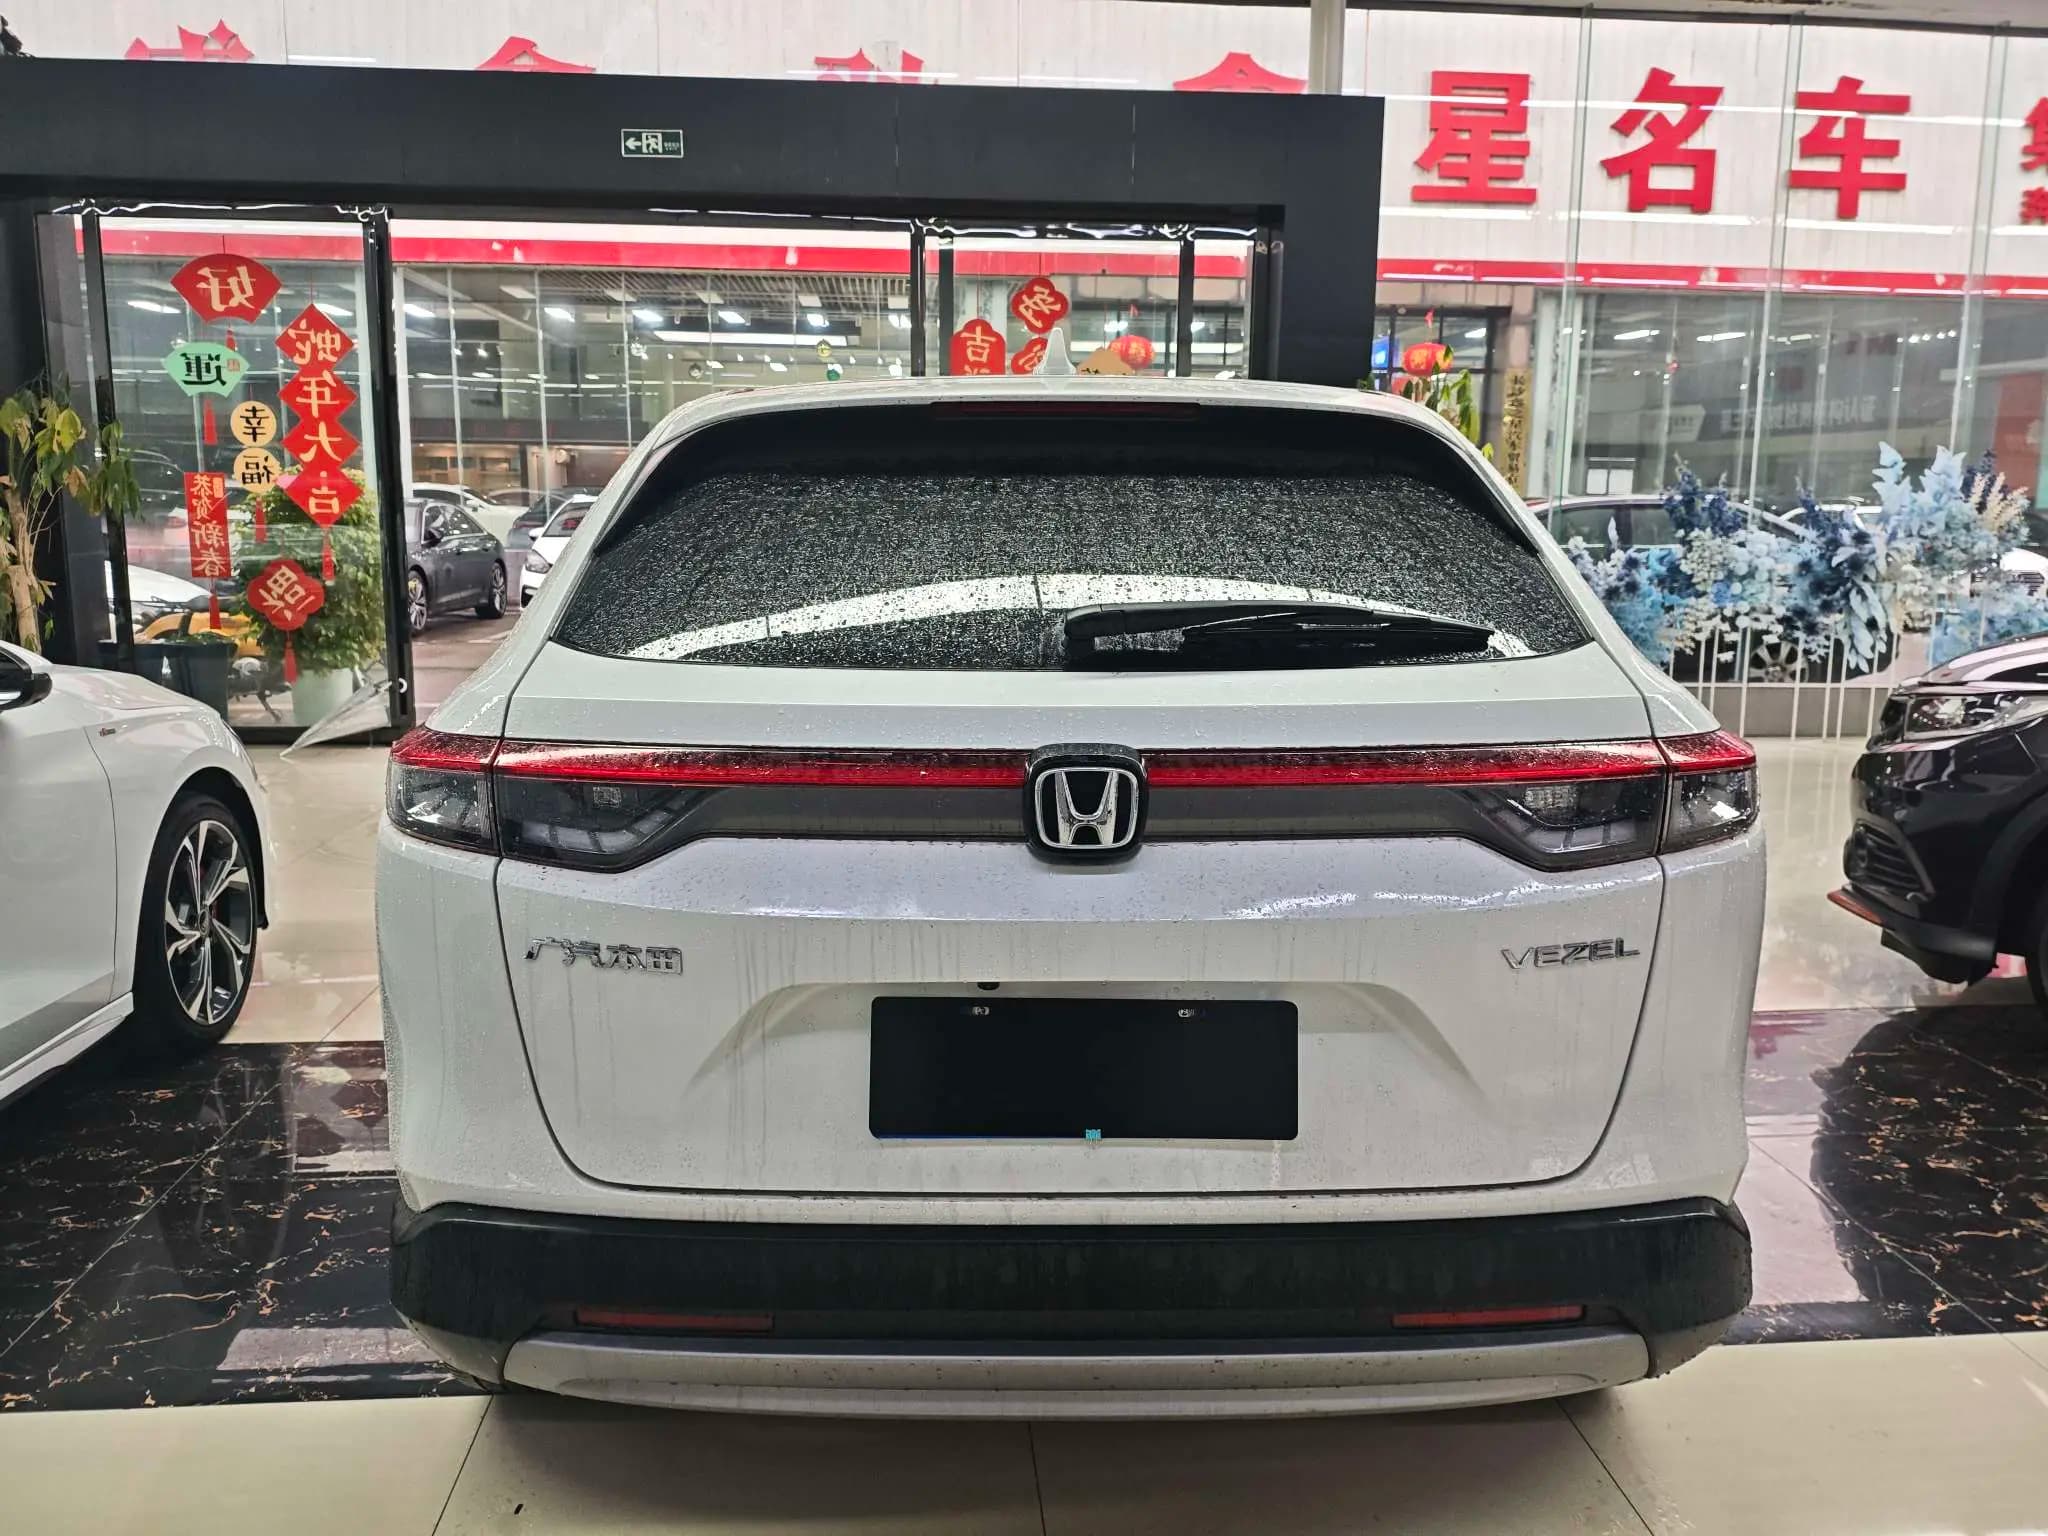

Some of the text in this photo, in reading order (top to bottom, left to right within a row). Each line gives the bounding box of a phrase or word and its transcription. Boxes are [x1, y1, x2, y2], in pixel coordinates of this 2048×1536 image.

[523, 936, 684, 975] 广汽本田
[1500, 937, 1641, 969] VEZEL
